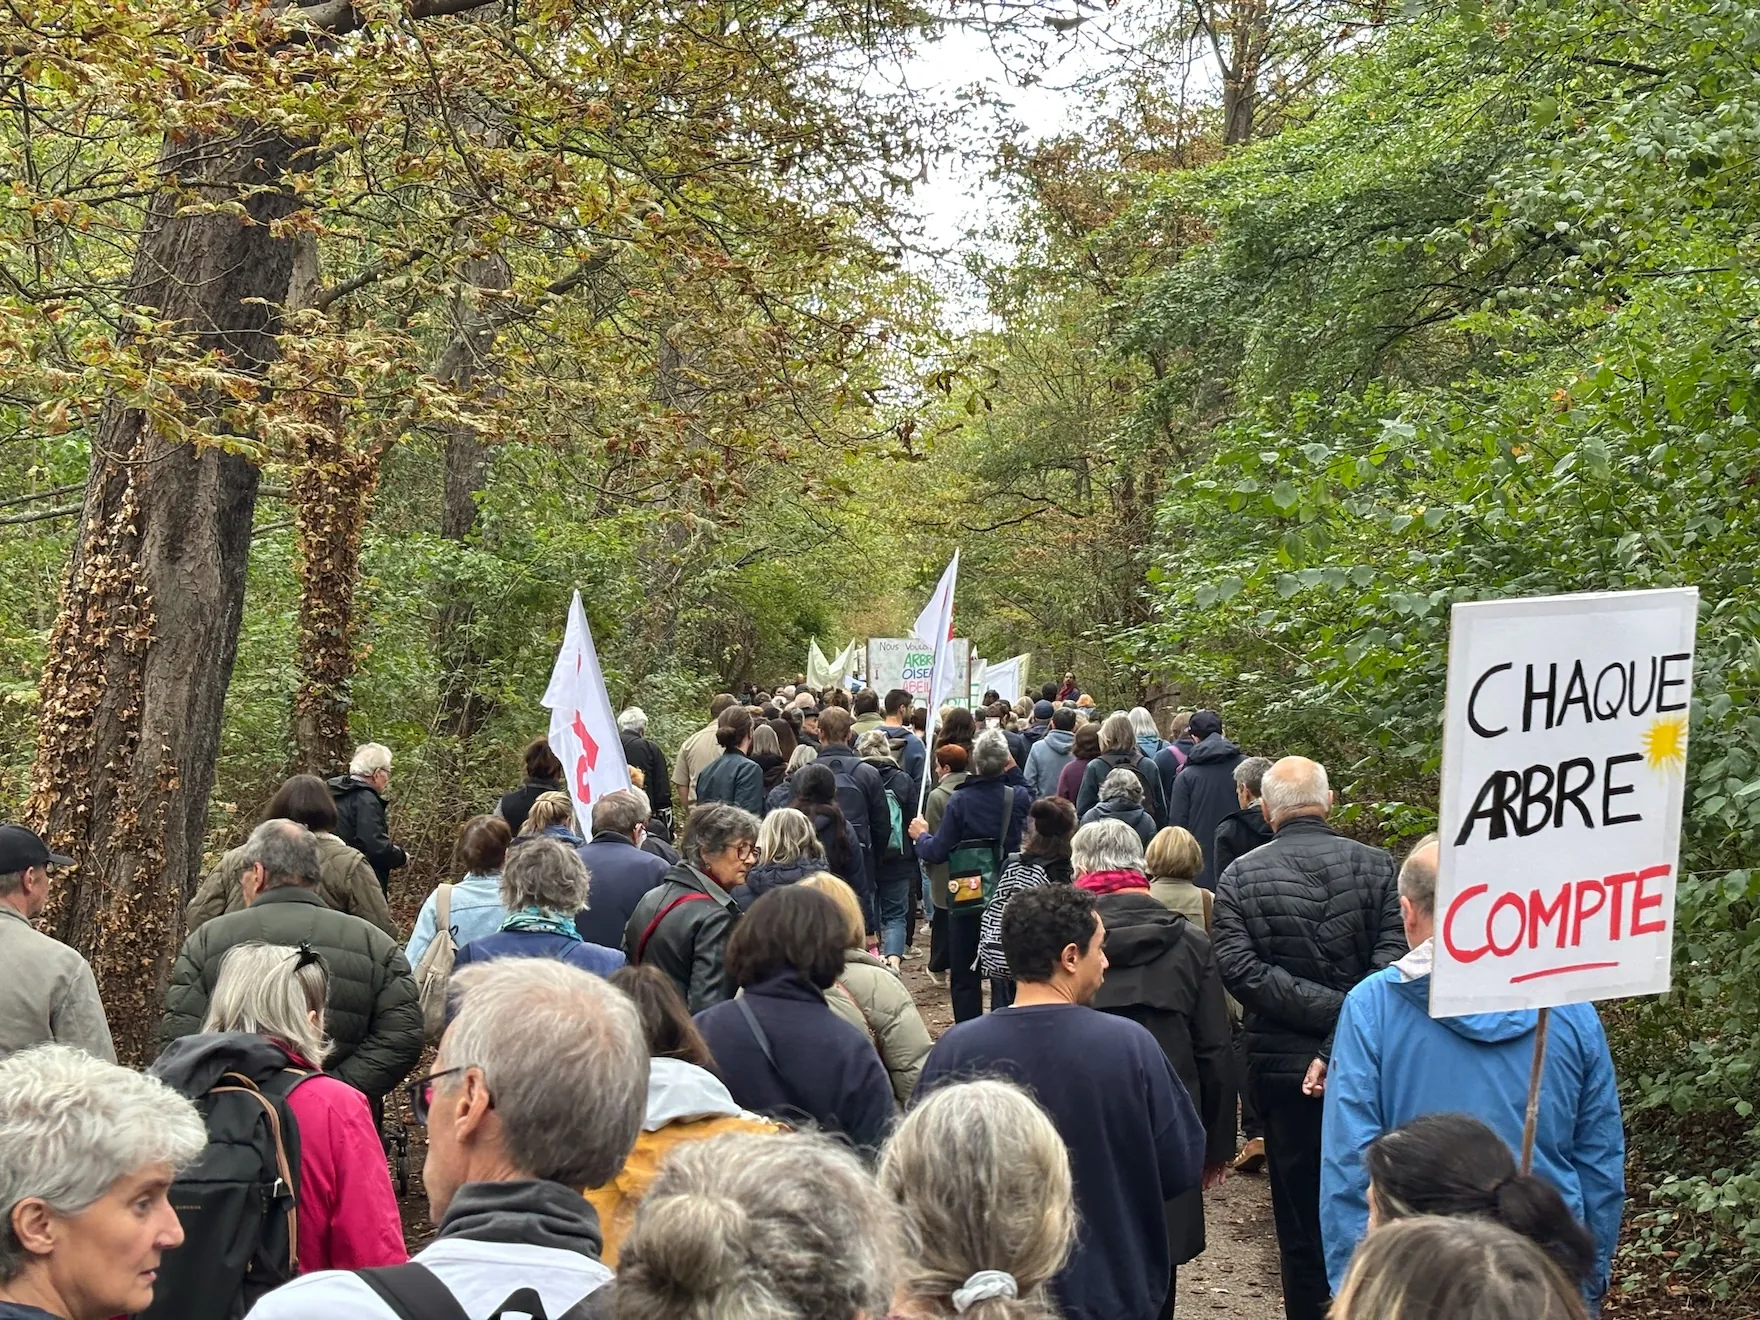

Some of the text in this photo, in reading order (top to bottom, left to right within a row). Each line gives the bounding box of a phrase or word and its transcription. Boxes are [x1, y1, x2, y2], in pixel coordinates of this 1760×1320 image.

[1467, 653, 1691, 739] CHAQUE
[1453, 752, 1644, 847] ARBRE
[1443, 864, 1671, 964] COMPTE
